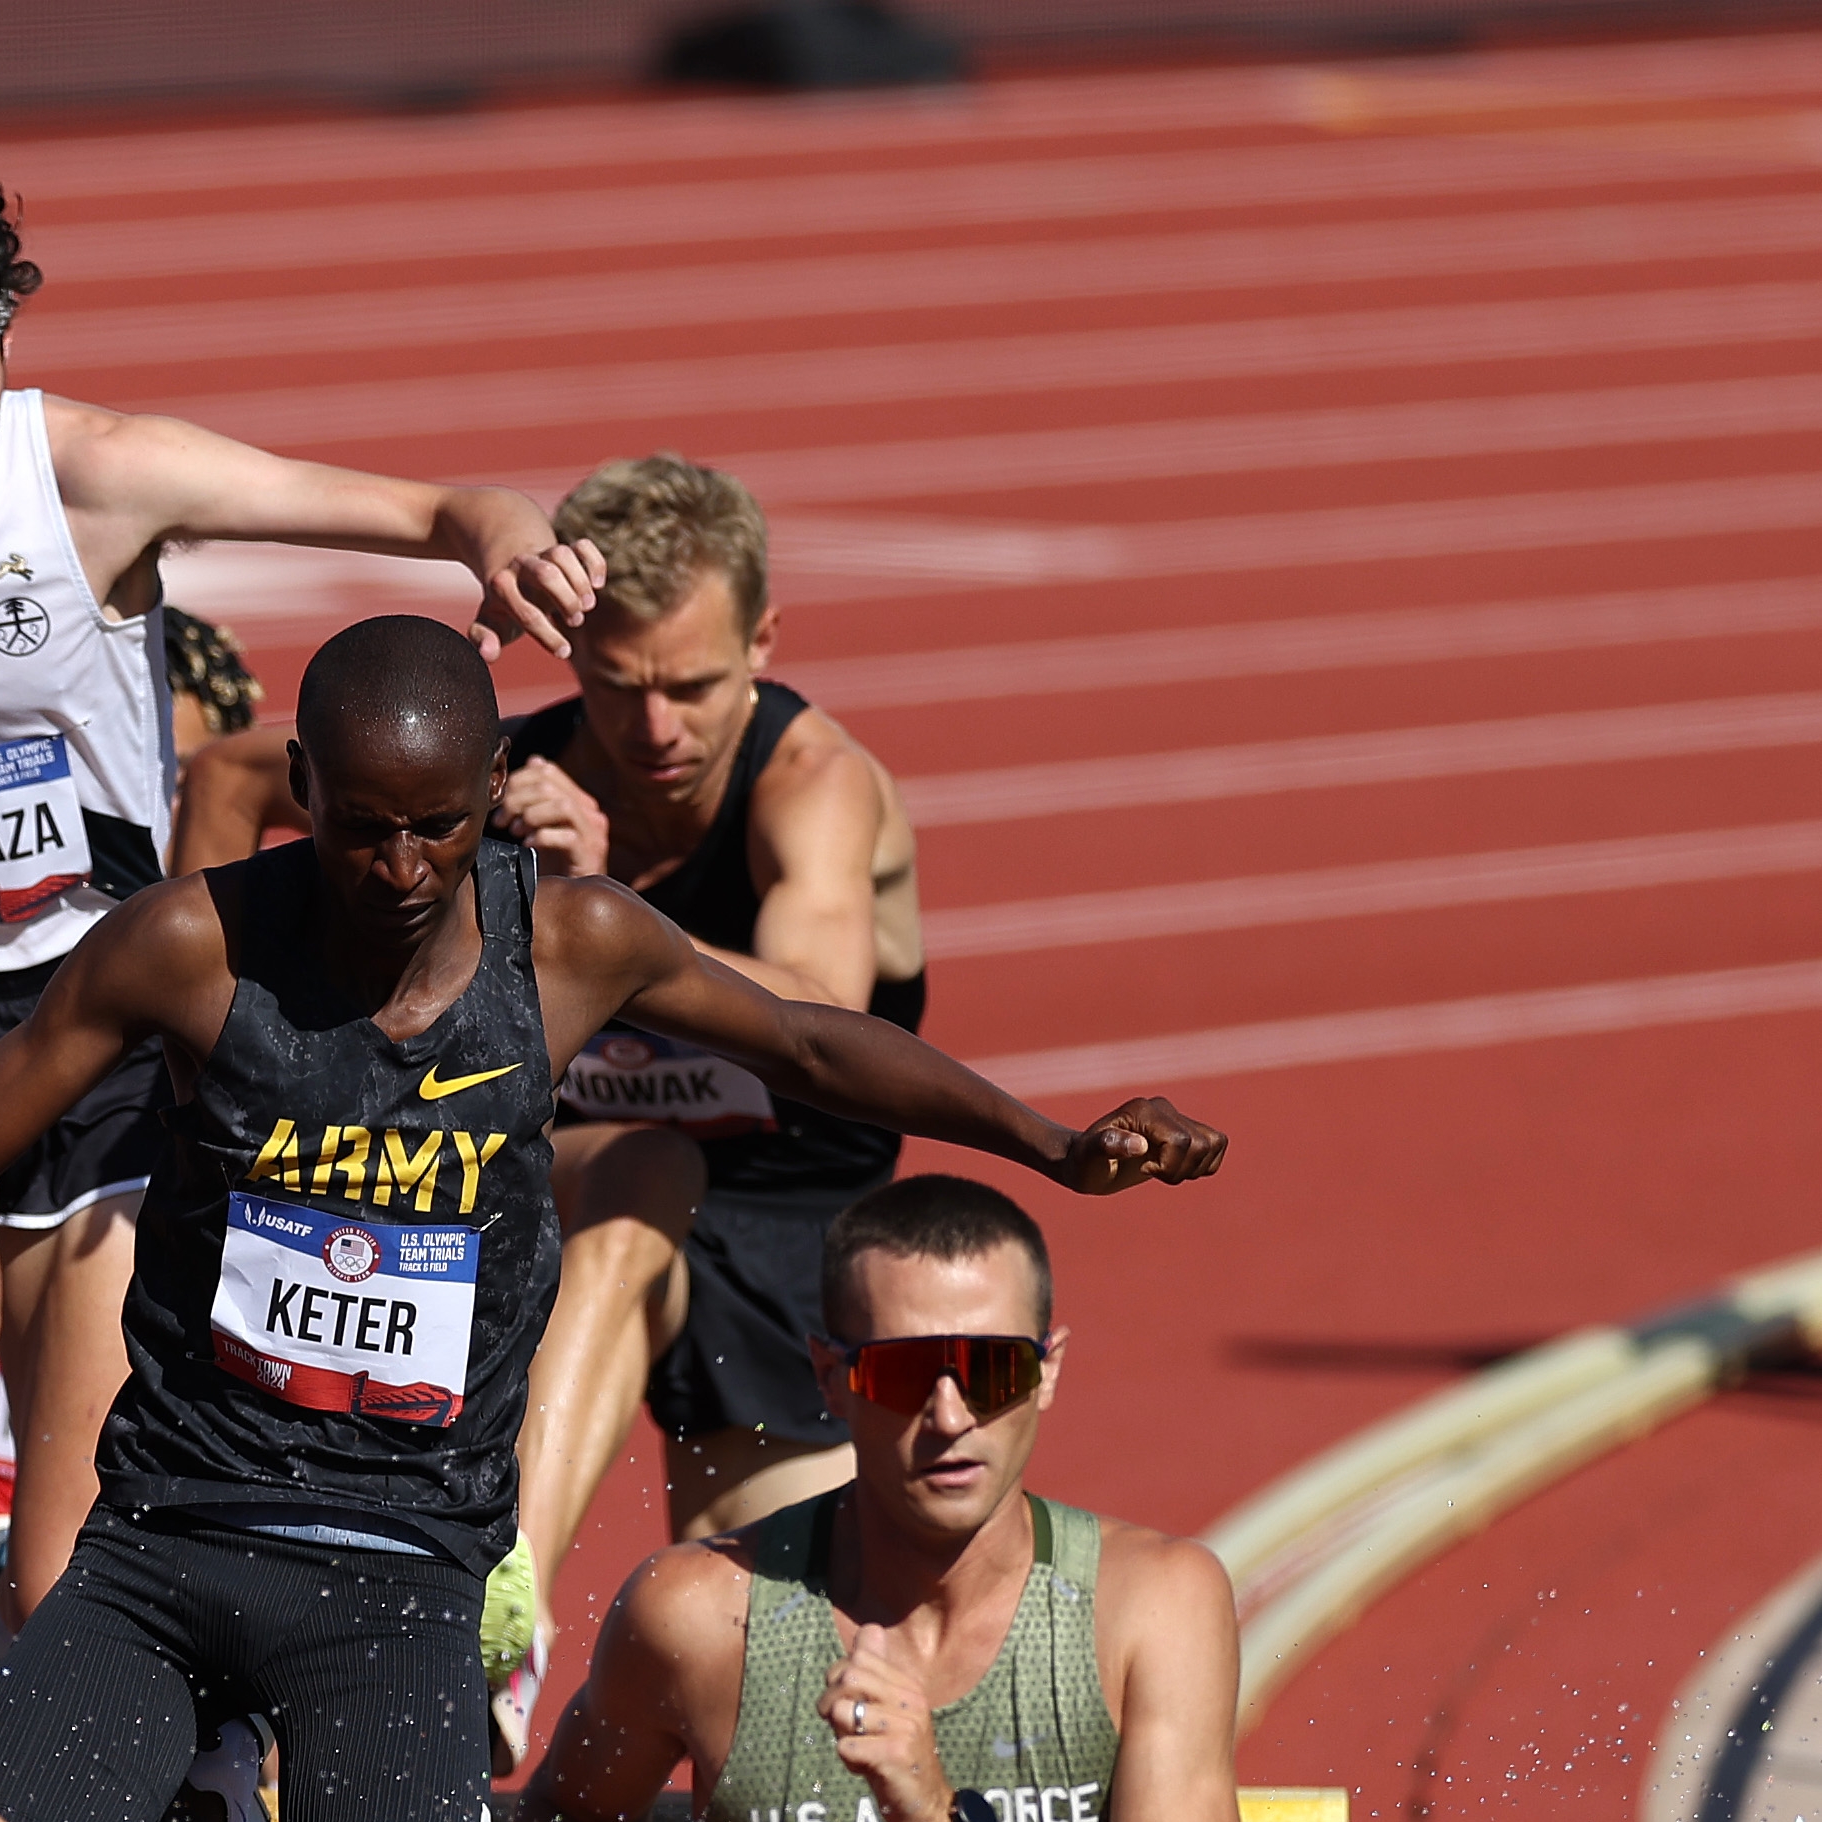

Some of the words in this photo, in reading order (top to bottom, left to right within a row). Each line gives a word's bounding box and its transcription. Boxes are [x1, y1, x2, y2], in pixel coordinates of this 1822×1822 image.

[564, 1063, 721, 1105] NOWAK
[244, 1118, 508, 1214] ARMY
[265, 1215, 314, 1238] USATF
[400, 1233, 420, 1247] U.S.
[423, 1233, 466, 1247] OLYMPIC
[399, 1247, 429, 1261] TEAM
[430, 1247, 465, 1261] TRIALS
[399, 1262, 422, 1272] TRACK
[430, 1262, 447, 1272] FIELD
[264, 1278, 418, 1356] KETER
[256, 1370, 286, 1391] 2024
